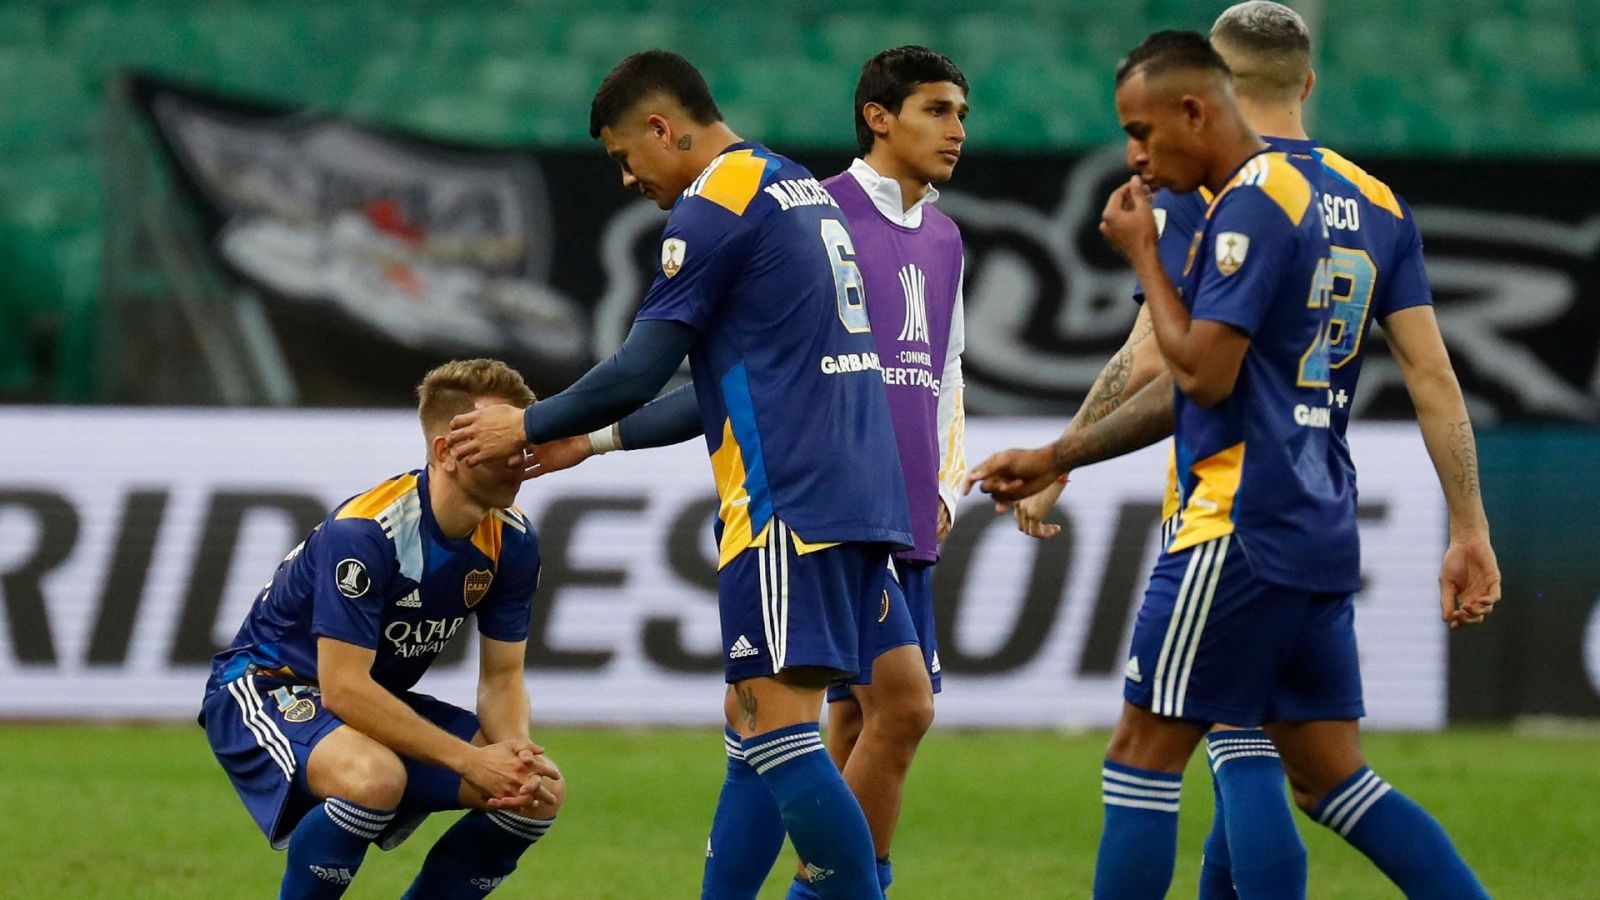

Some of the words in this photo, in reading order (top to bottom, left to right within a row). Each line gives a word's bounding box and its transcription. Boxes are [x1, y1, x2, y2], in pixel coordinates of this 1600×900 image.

[1323, 193, 1360, 231] SCO
[821, 219, 871, 333] 6
[396, 600, 423, 608] adidas
[385, 617, 464, 648] QATAR
[730, 648, 759, 659] adidas
